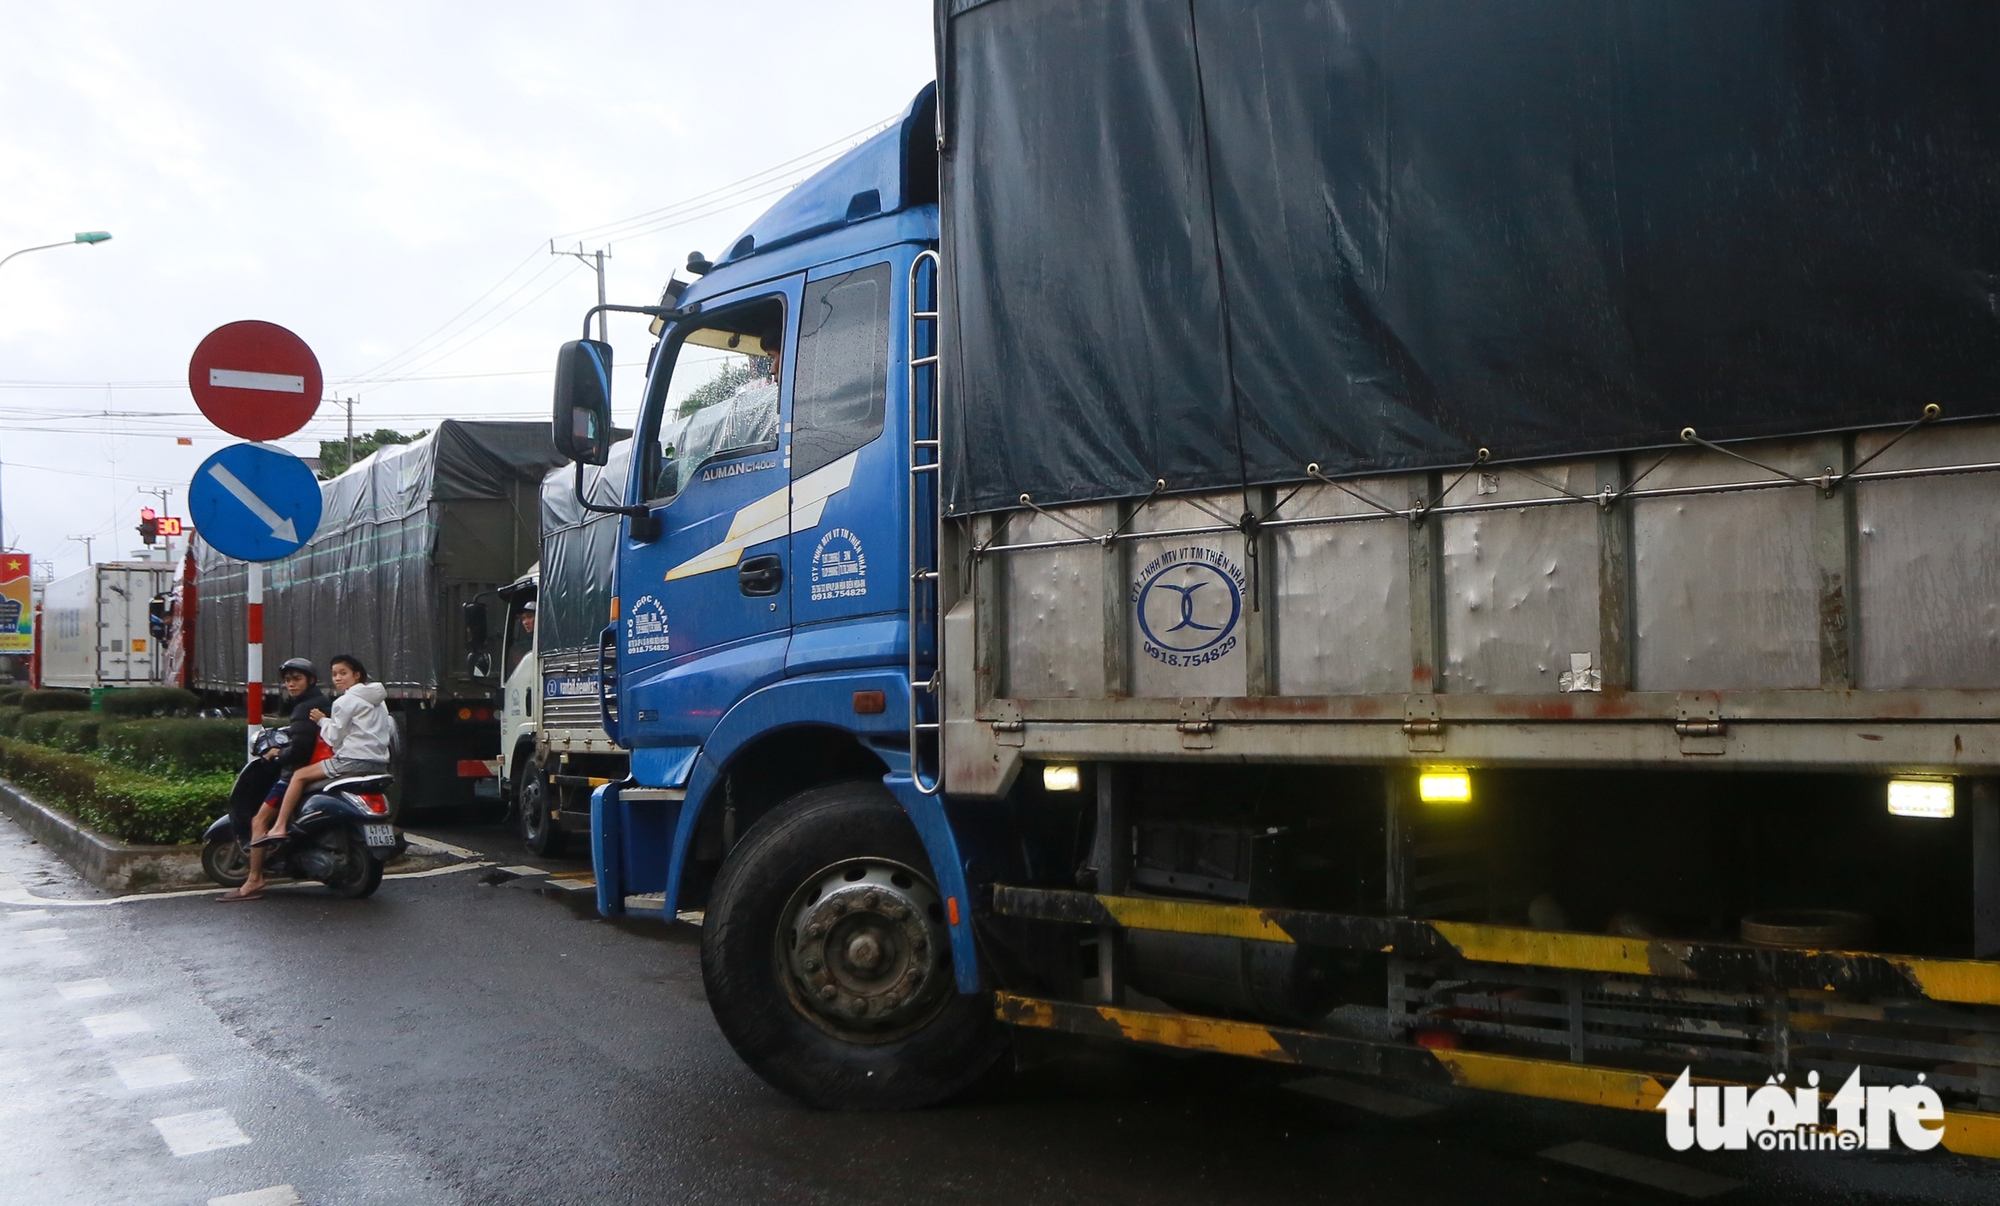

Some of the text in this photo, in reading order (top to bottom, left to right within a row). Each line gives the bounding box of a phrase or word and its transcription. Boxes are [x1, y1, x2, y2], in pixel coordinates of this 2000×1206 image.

[702, 462, 745, 482] AUMAN
[158, 518, 180, 535] 30
[1130, 580, 1142, 603] CTY
[1141, 558, 1160, 581] TNHH
[1161, 550, 1178, 566] MTV
[1180, 547, 1189, 560] VT
[1190, 547, 1203, 559] TM
[1205, 549, 1229, 570] THIỆN
[811, 588, 867, 601] 0918.754829
[1143, 635, 1237, 668] 0918.754829
